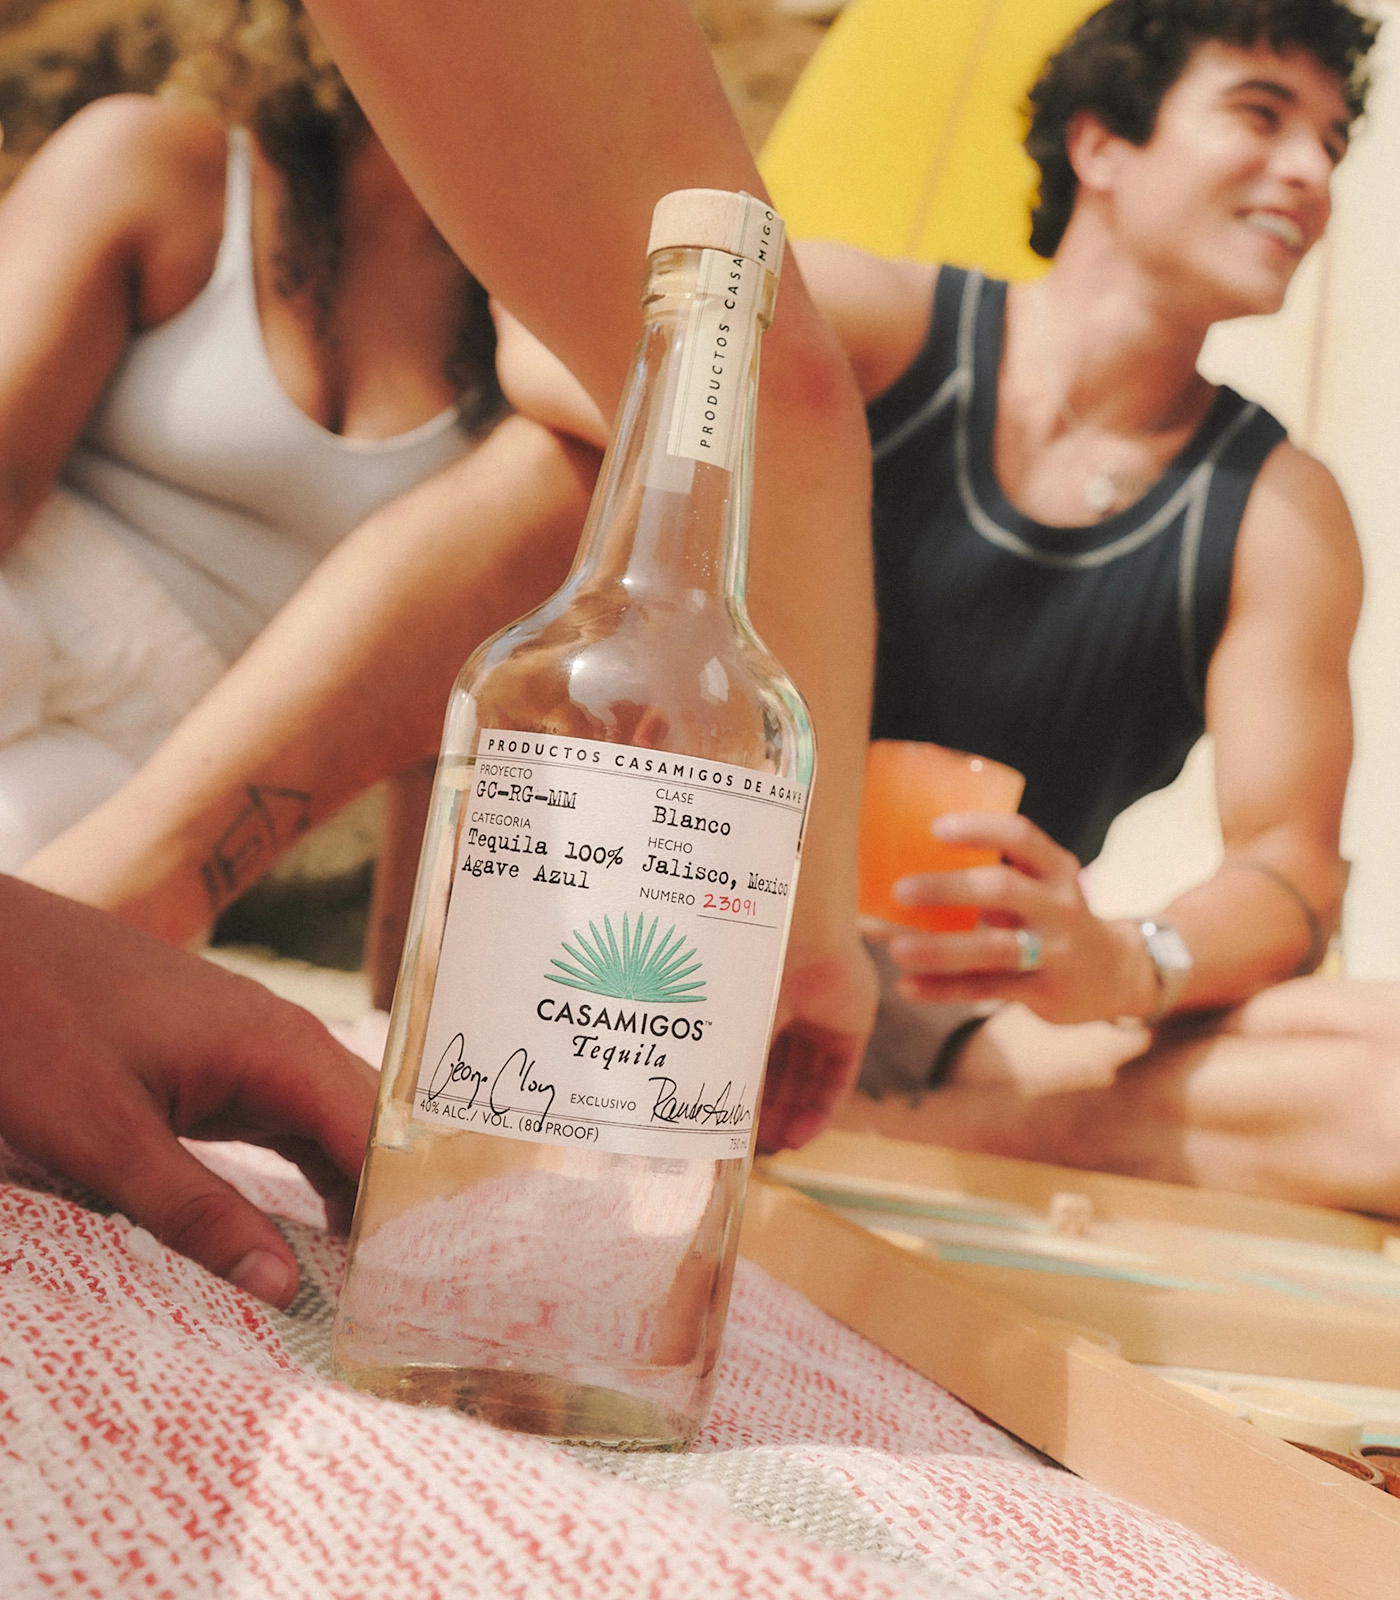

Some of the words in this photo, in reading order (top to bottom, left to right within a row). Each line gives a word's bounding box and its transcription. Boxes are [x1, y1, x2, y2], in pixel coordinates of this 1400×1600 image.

[700, 323, 731, 449] PRODUCTOS
[480, 763, 533, 780] PROYECTO
[488, 738, 601, 763] PRODUCTOS
[615, 755, 734, 787] CASAMIGOS
[744, 778, 763, 793] DE
[769, 785, 802, 804] AGAVE
[655, 788, 694, 805] CLASE
[471, 811, 532, 829] CATEGORIA
[651, 805, 731, 836] Blanco
[468, 827, 548, 856] Tequila
[564, 841, 624, 869] 100%
[647, 836, 693, 854] HECHO
[461, 854, 520, 877] Agave
[532, 864, 590, 890] Azul
[642, 854, 738, 891] Jalisco,
[747, 872, 789, 897] Mexico
[639, 887, 696, 906] NUMERO
[702, 893, 757, 917] 23091
[572, 1035, 667, 1071] Tequila
[570, 1093, 637, 1112] EXCLUSIVO
[419, 1099, 440, 1115] 40%
[482, 1111, 513, 1130] VOL.
[518, 1116, 542, 1133] (80
[545, 1121, 600, 1143] PROOF)
